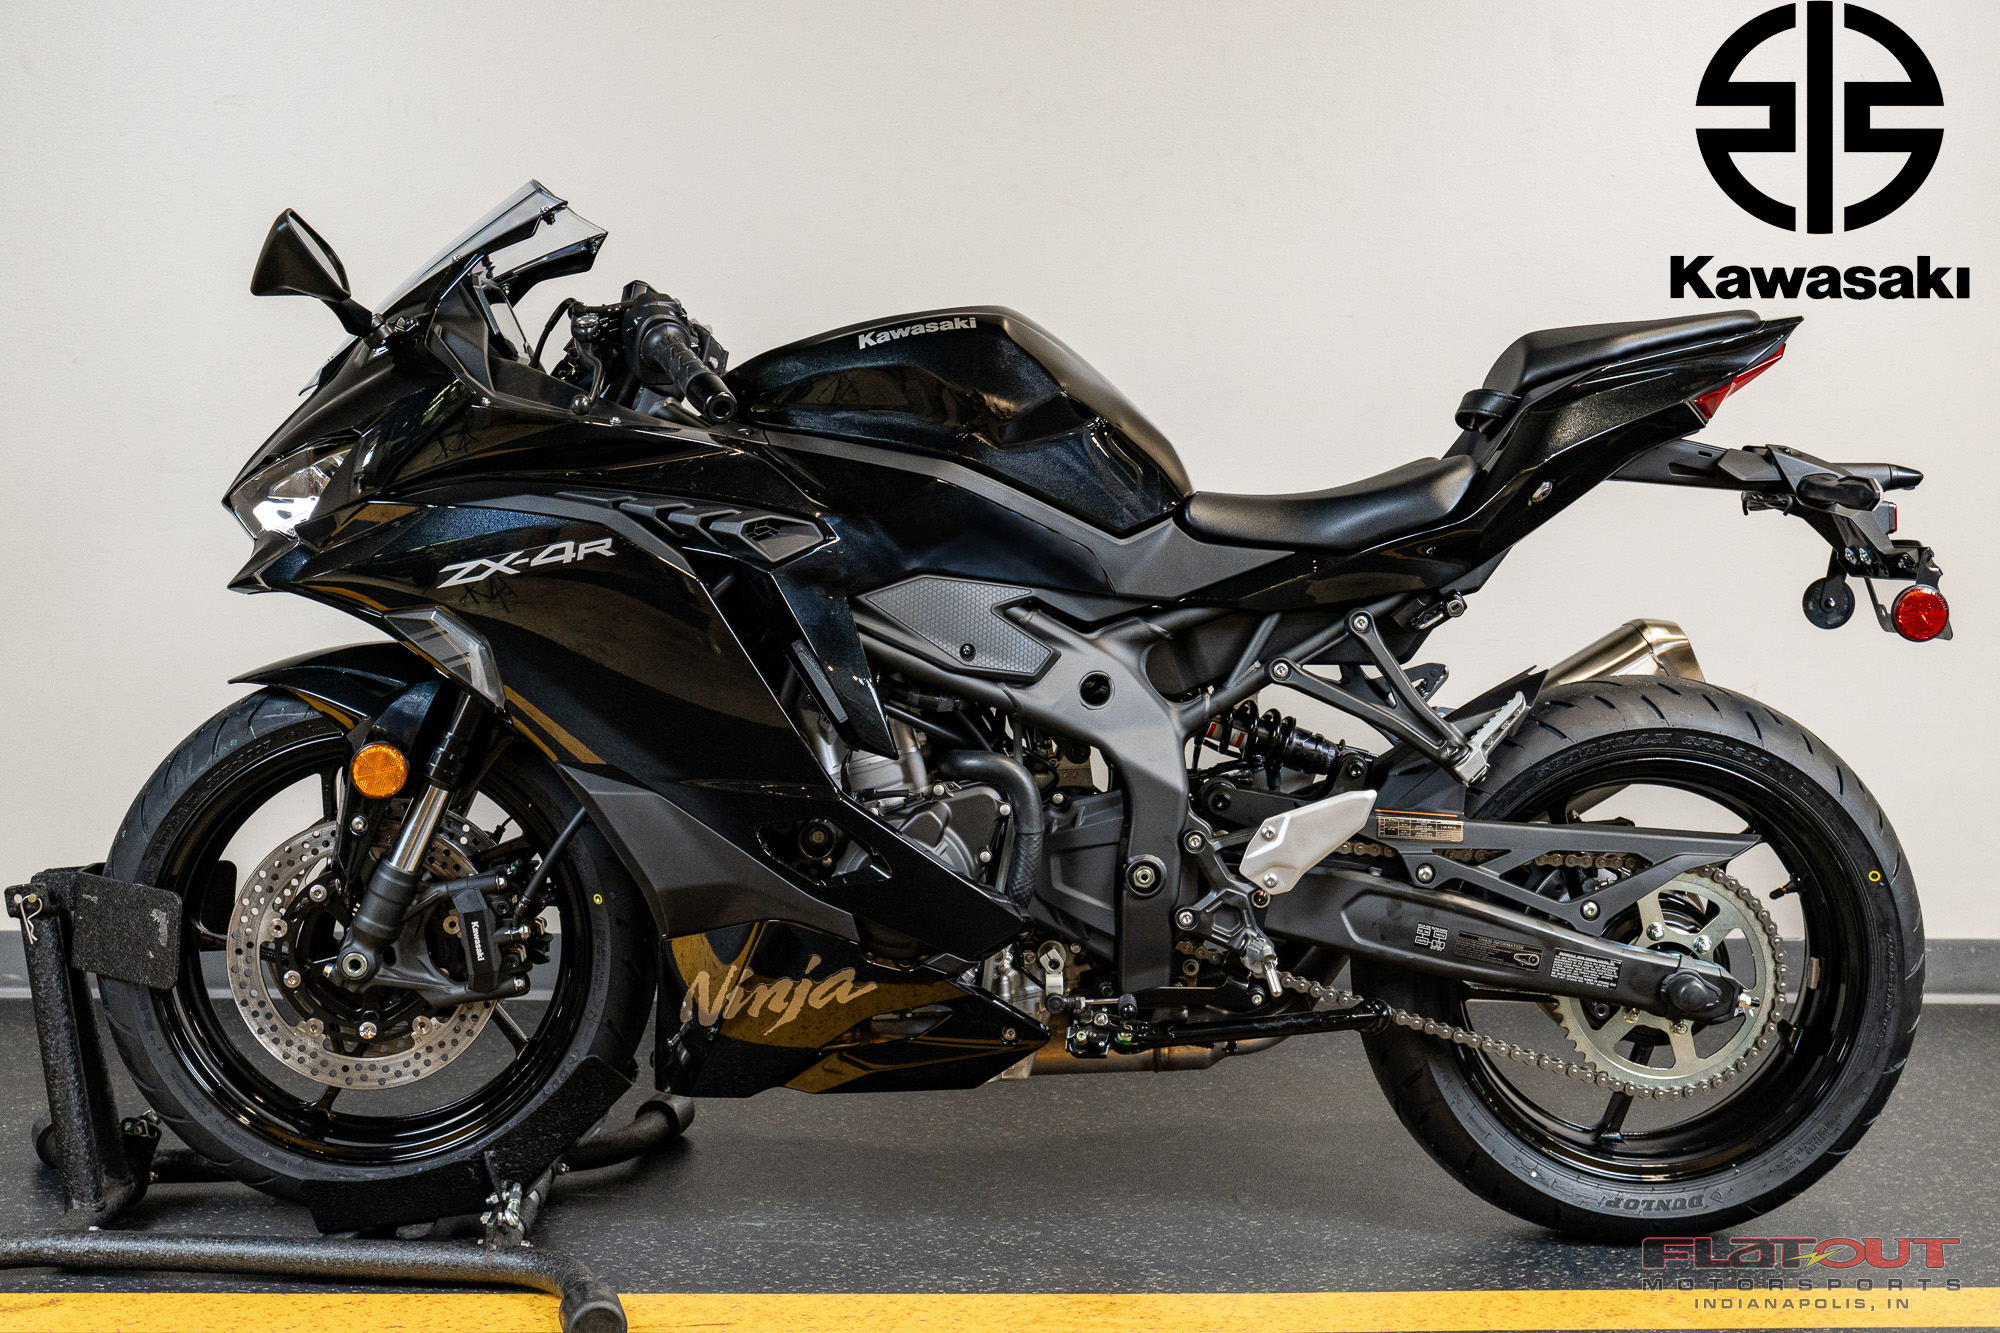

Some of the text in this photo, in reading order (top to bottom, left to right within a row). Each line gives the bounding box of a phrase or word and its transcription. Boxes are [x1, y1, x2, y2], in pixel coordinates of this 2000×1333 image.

[858, 317, 977, 350] Kawasaki
[436, 537, 618, 589] ZX-4R
[471, 921, 485, 962] Kawasaki
[680, 954, 878, 1036] Ninja
[1604, 1194, 1704, 1212] DUNLOP
